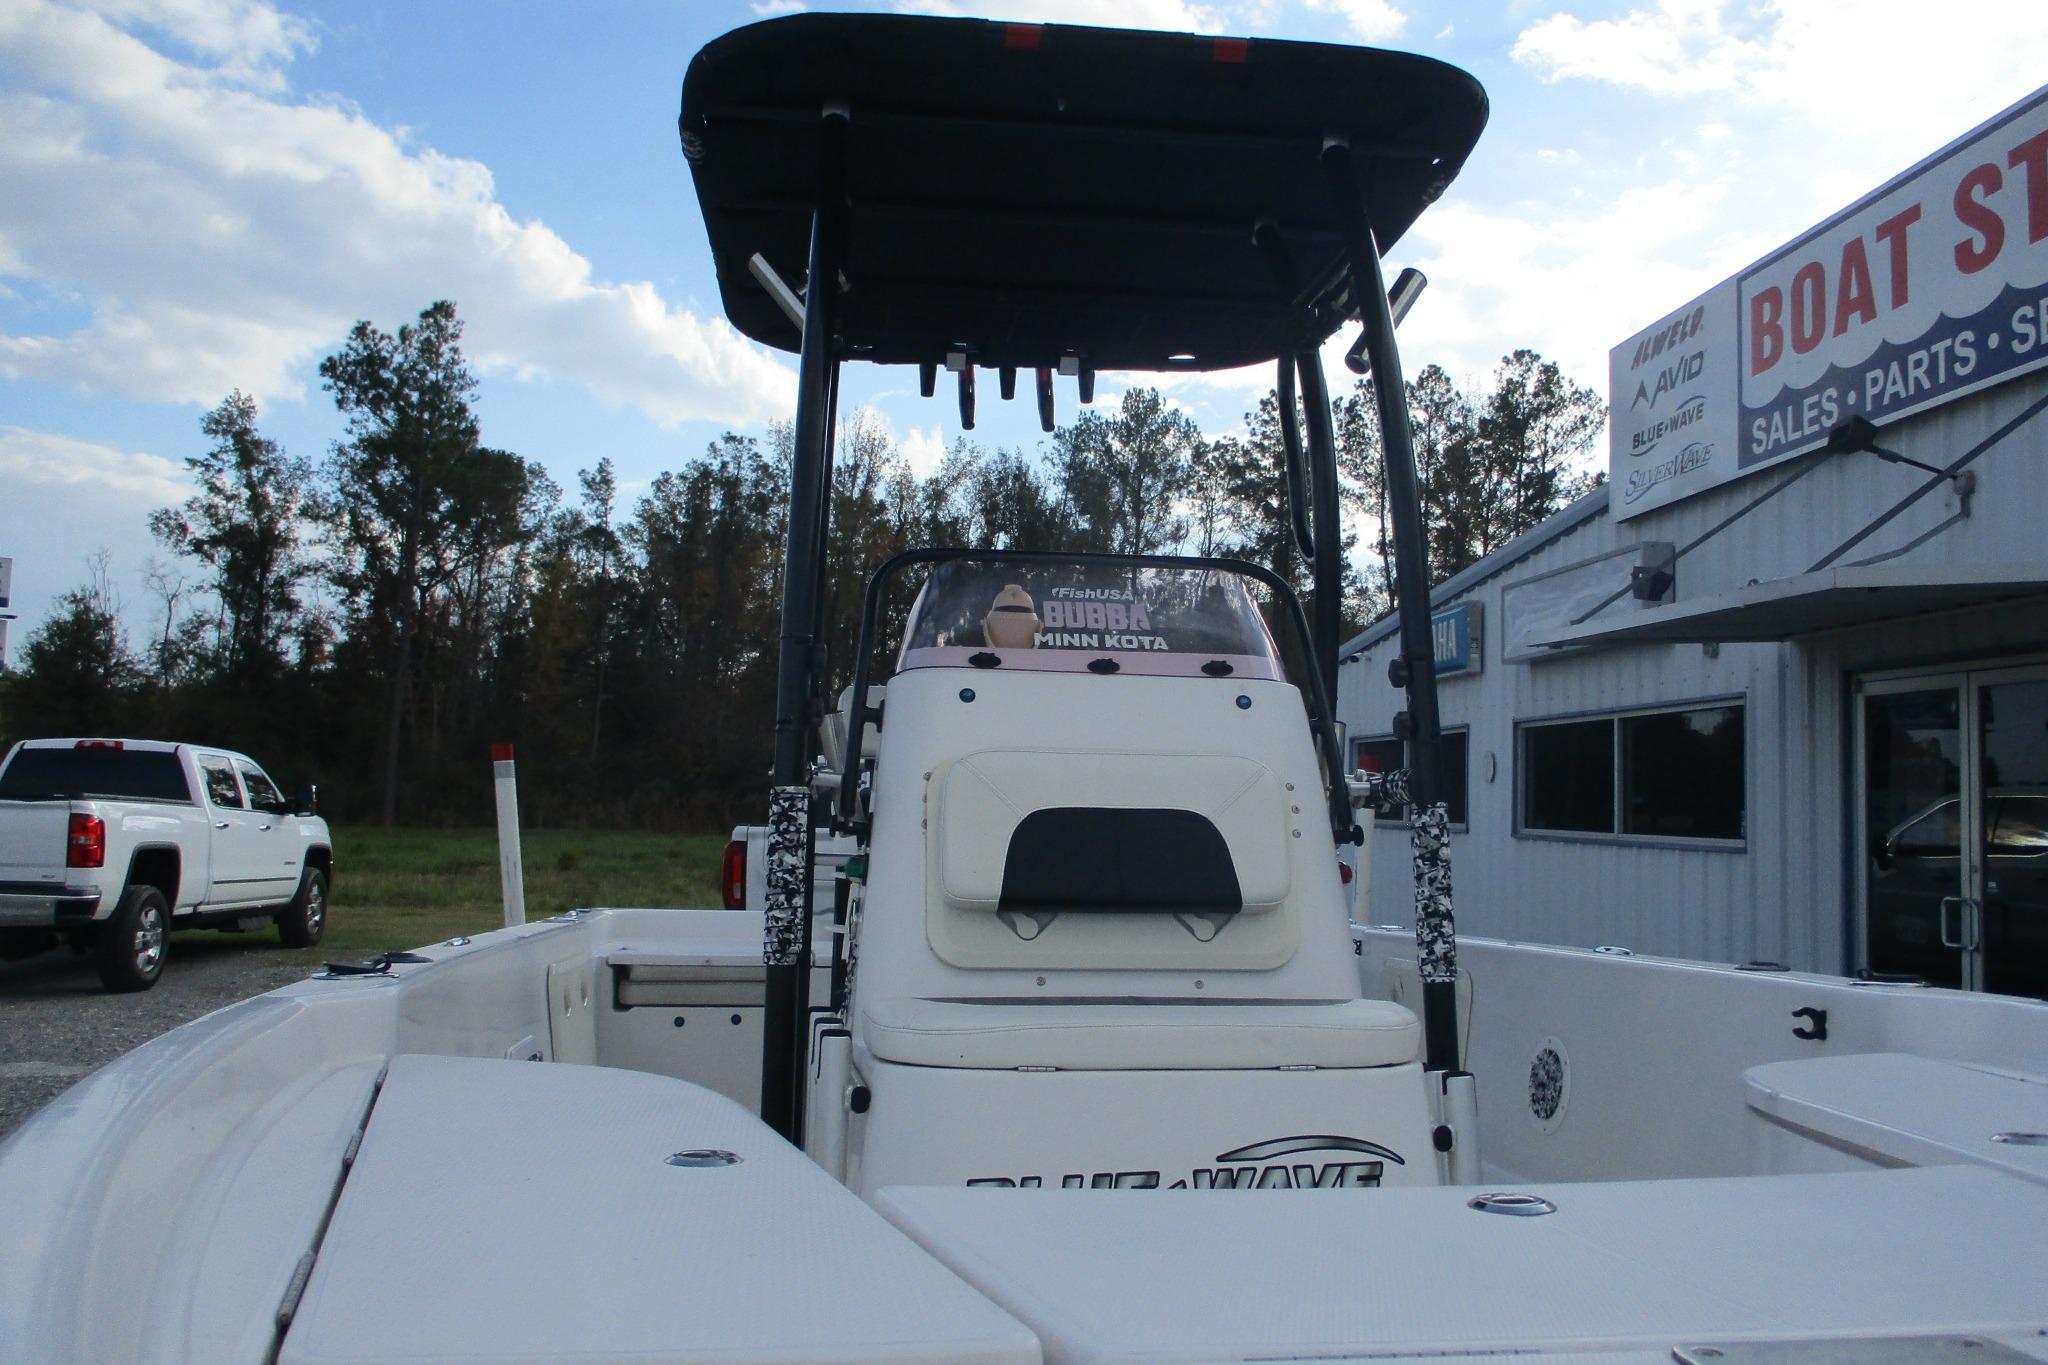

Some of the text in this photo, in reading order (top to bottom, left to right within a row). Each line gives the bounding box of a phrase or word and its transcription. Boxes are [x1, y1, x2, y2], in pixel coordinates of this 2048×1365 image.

[1751, 202, 1921, 377] BOAT
[1649, 350, 1704, 410] AVID
[1751, 389, 1840, 455] SALES
[1865, 331, 1977, 412] PARTS
[1043, 600, 1152, 630] BUBBA
[1058, 587, 1134, 601] FishUSA
[1033, 632, 1169, 650] MINN KOTA
